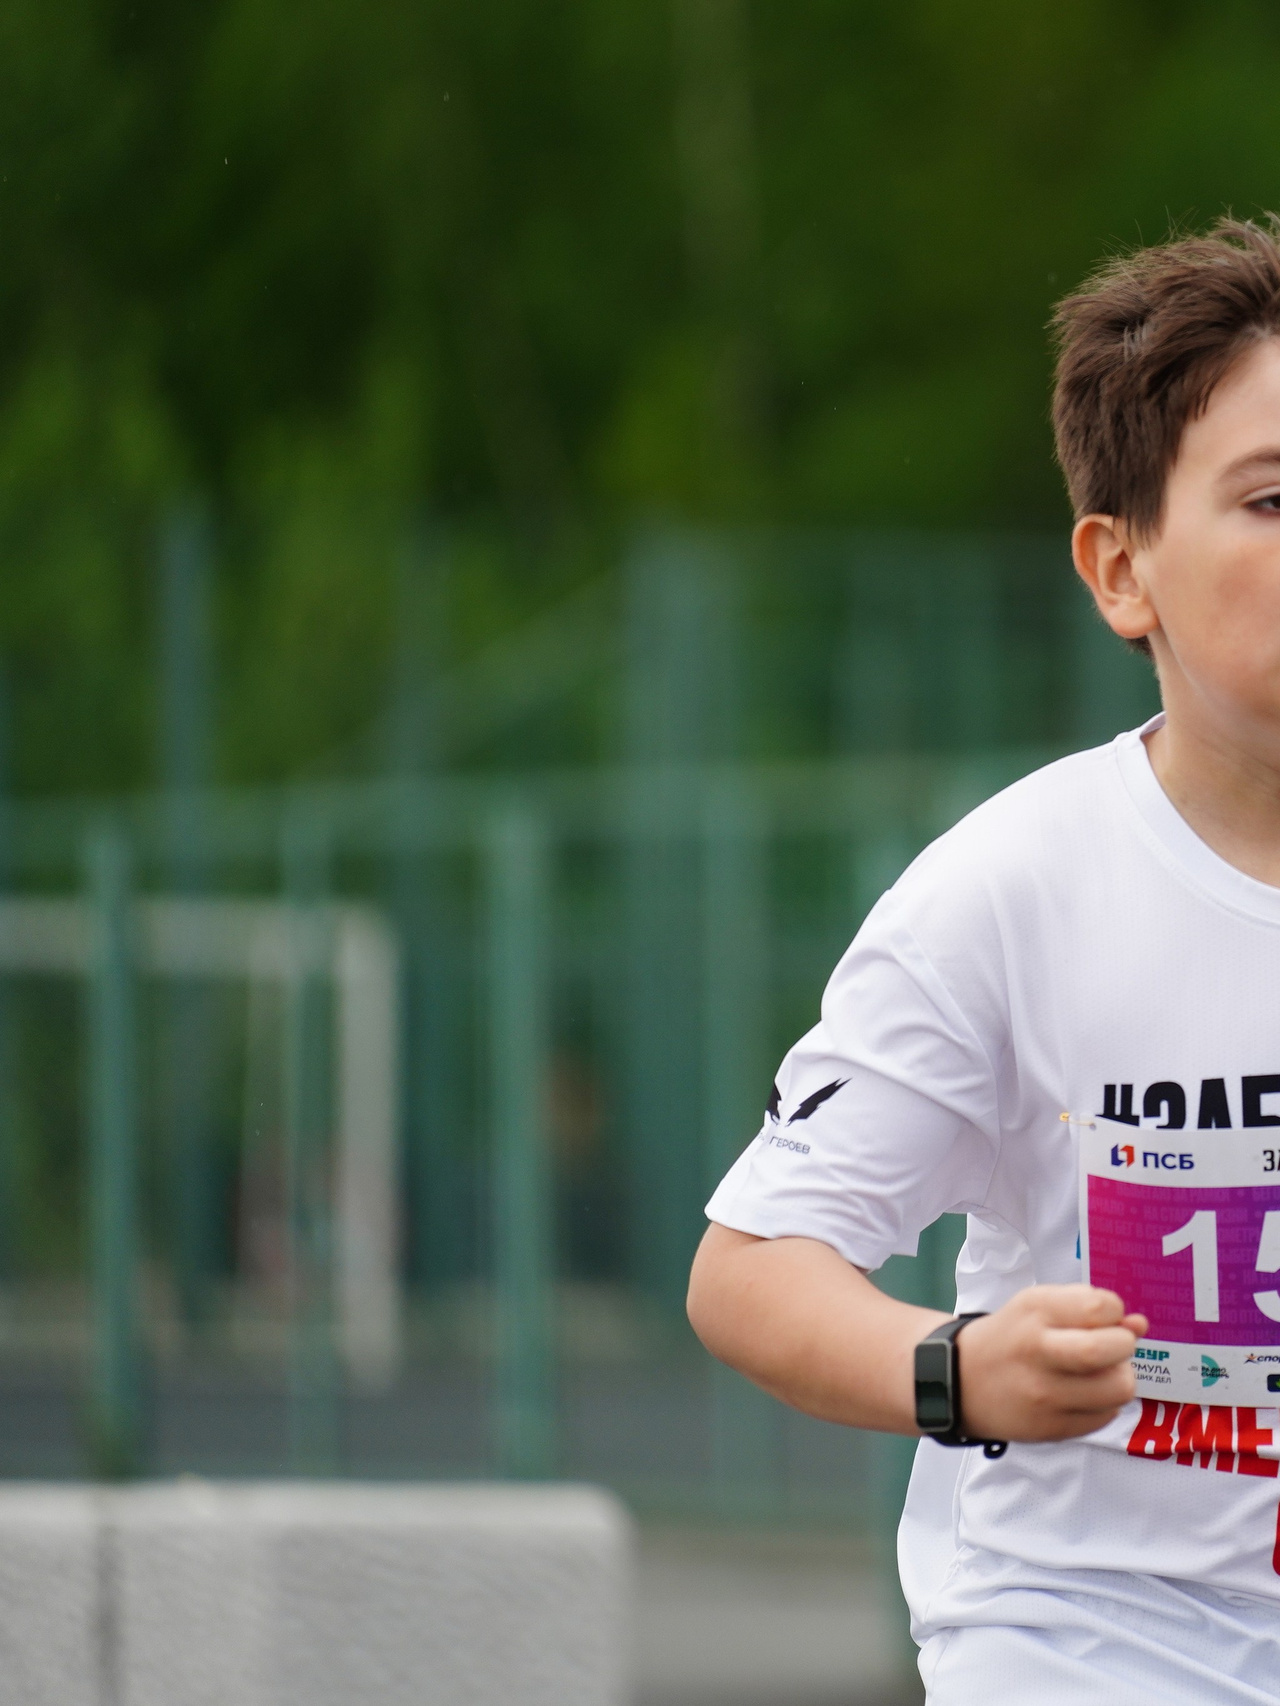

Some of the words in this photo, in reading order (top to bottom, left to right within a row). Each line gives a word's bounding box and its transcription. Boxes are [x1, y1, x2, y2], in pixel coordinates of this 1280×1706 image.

[769, 1136, 811, 1155] ГЕРОЕВ
[1142, 1151, 1195, 1171] ПСБ
[1134, 1347, 1170, 1361] БУР
